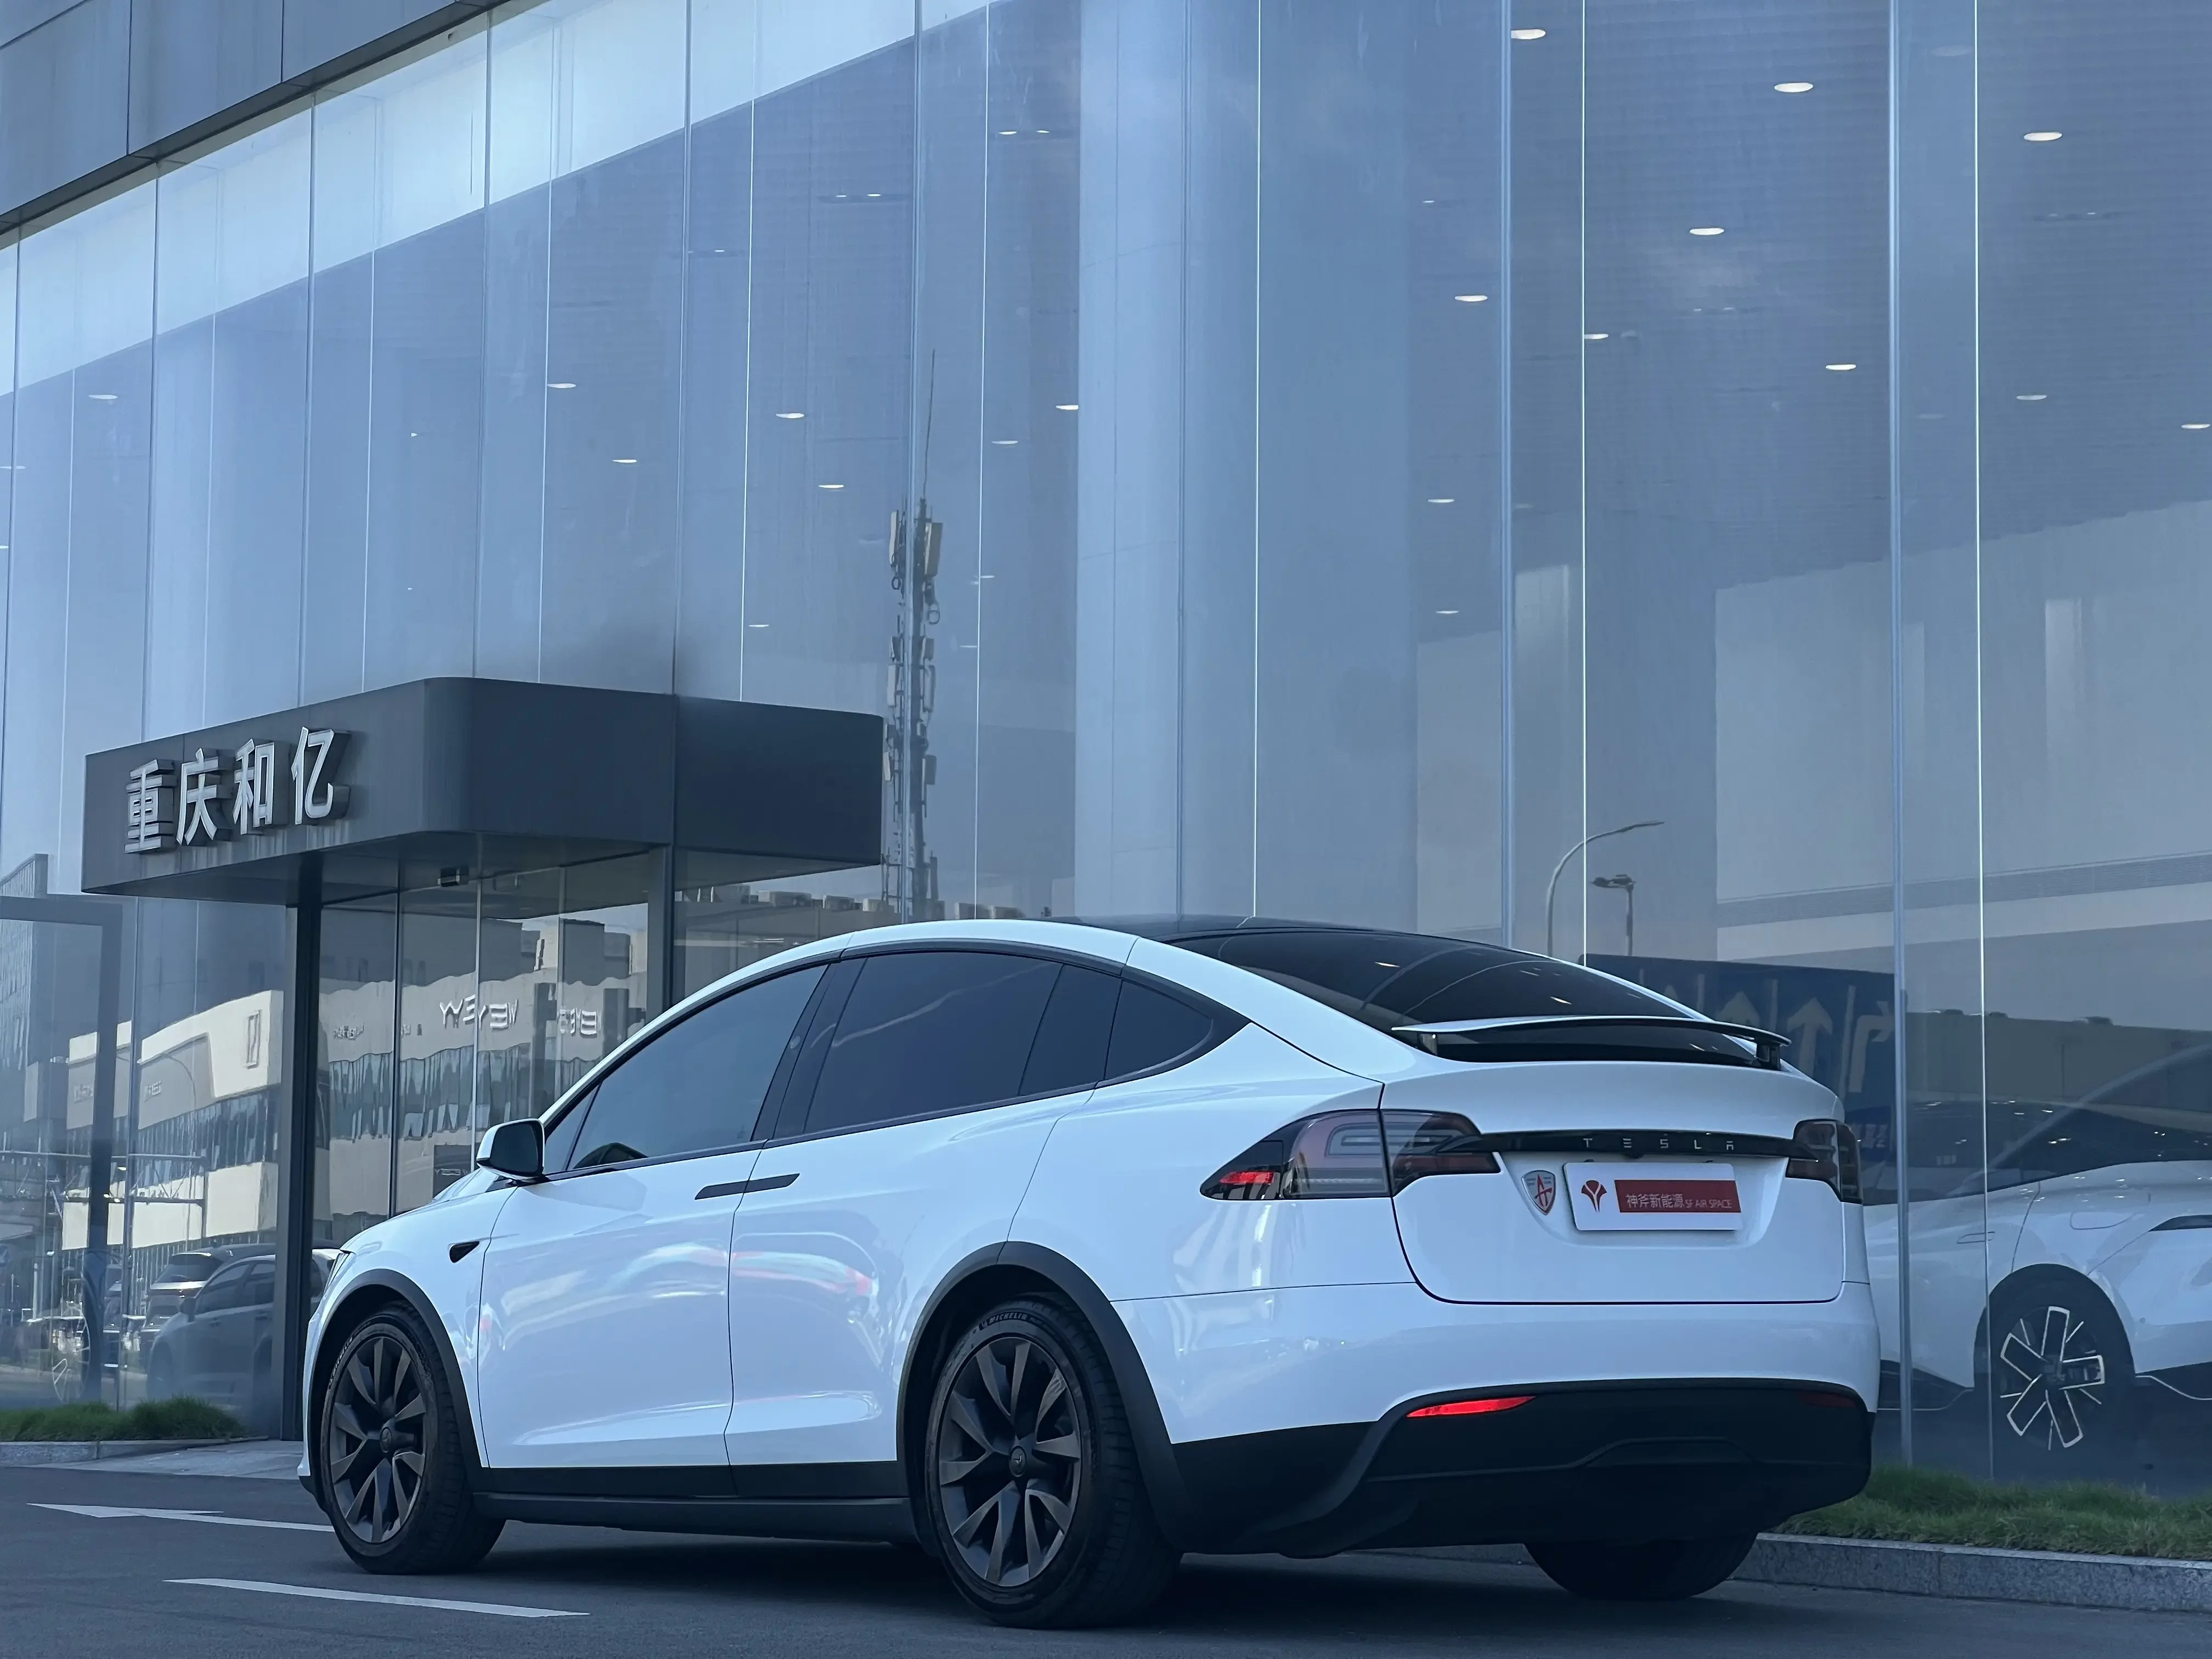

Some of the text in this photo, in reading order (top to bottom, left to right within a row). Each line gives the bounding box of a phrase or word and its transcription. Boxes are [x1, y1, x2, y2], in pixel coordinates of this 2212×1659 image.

[124, 727, 335, 854] 重庆和亿
[1583, 1137, 1734, 1151] TESLA
[1625, 1193, 1733, 1209] 神斧新能源 SF AIR SPACE
[989, 1312, 1028, 1324] MICHELIN
